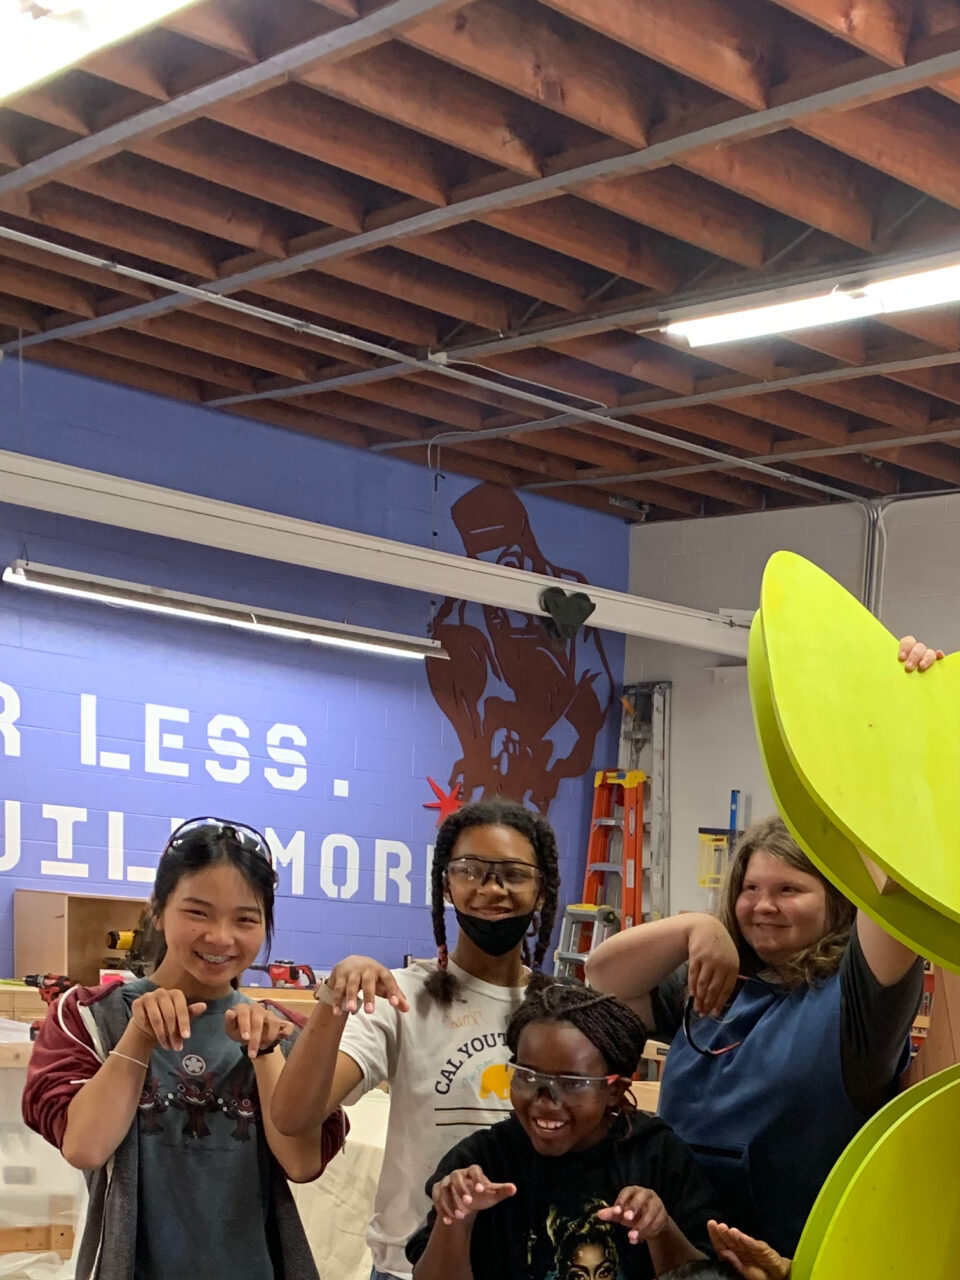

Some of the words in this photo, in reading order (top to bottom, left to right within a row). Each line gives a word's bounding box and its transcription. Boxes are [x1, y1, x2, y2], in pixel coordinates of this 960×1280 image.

[80, 693, 349, 798] LESS.
[0, 800, 185, 884] UIL
[434, 1058, 463, 1096] CAL
[457, 1032, 509, 1059] YOUT
